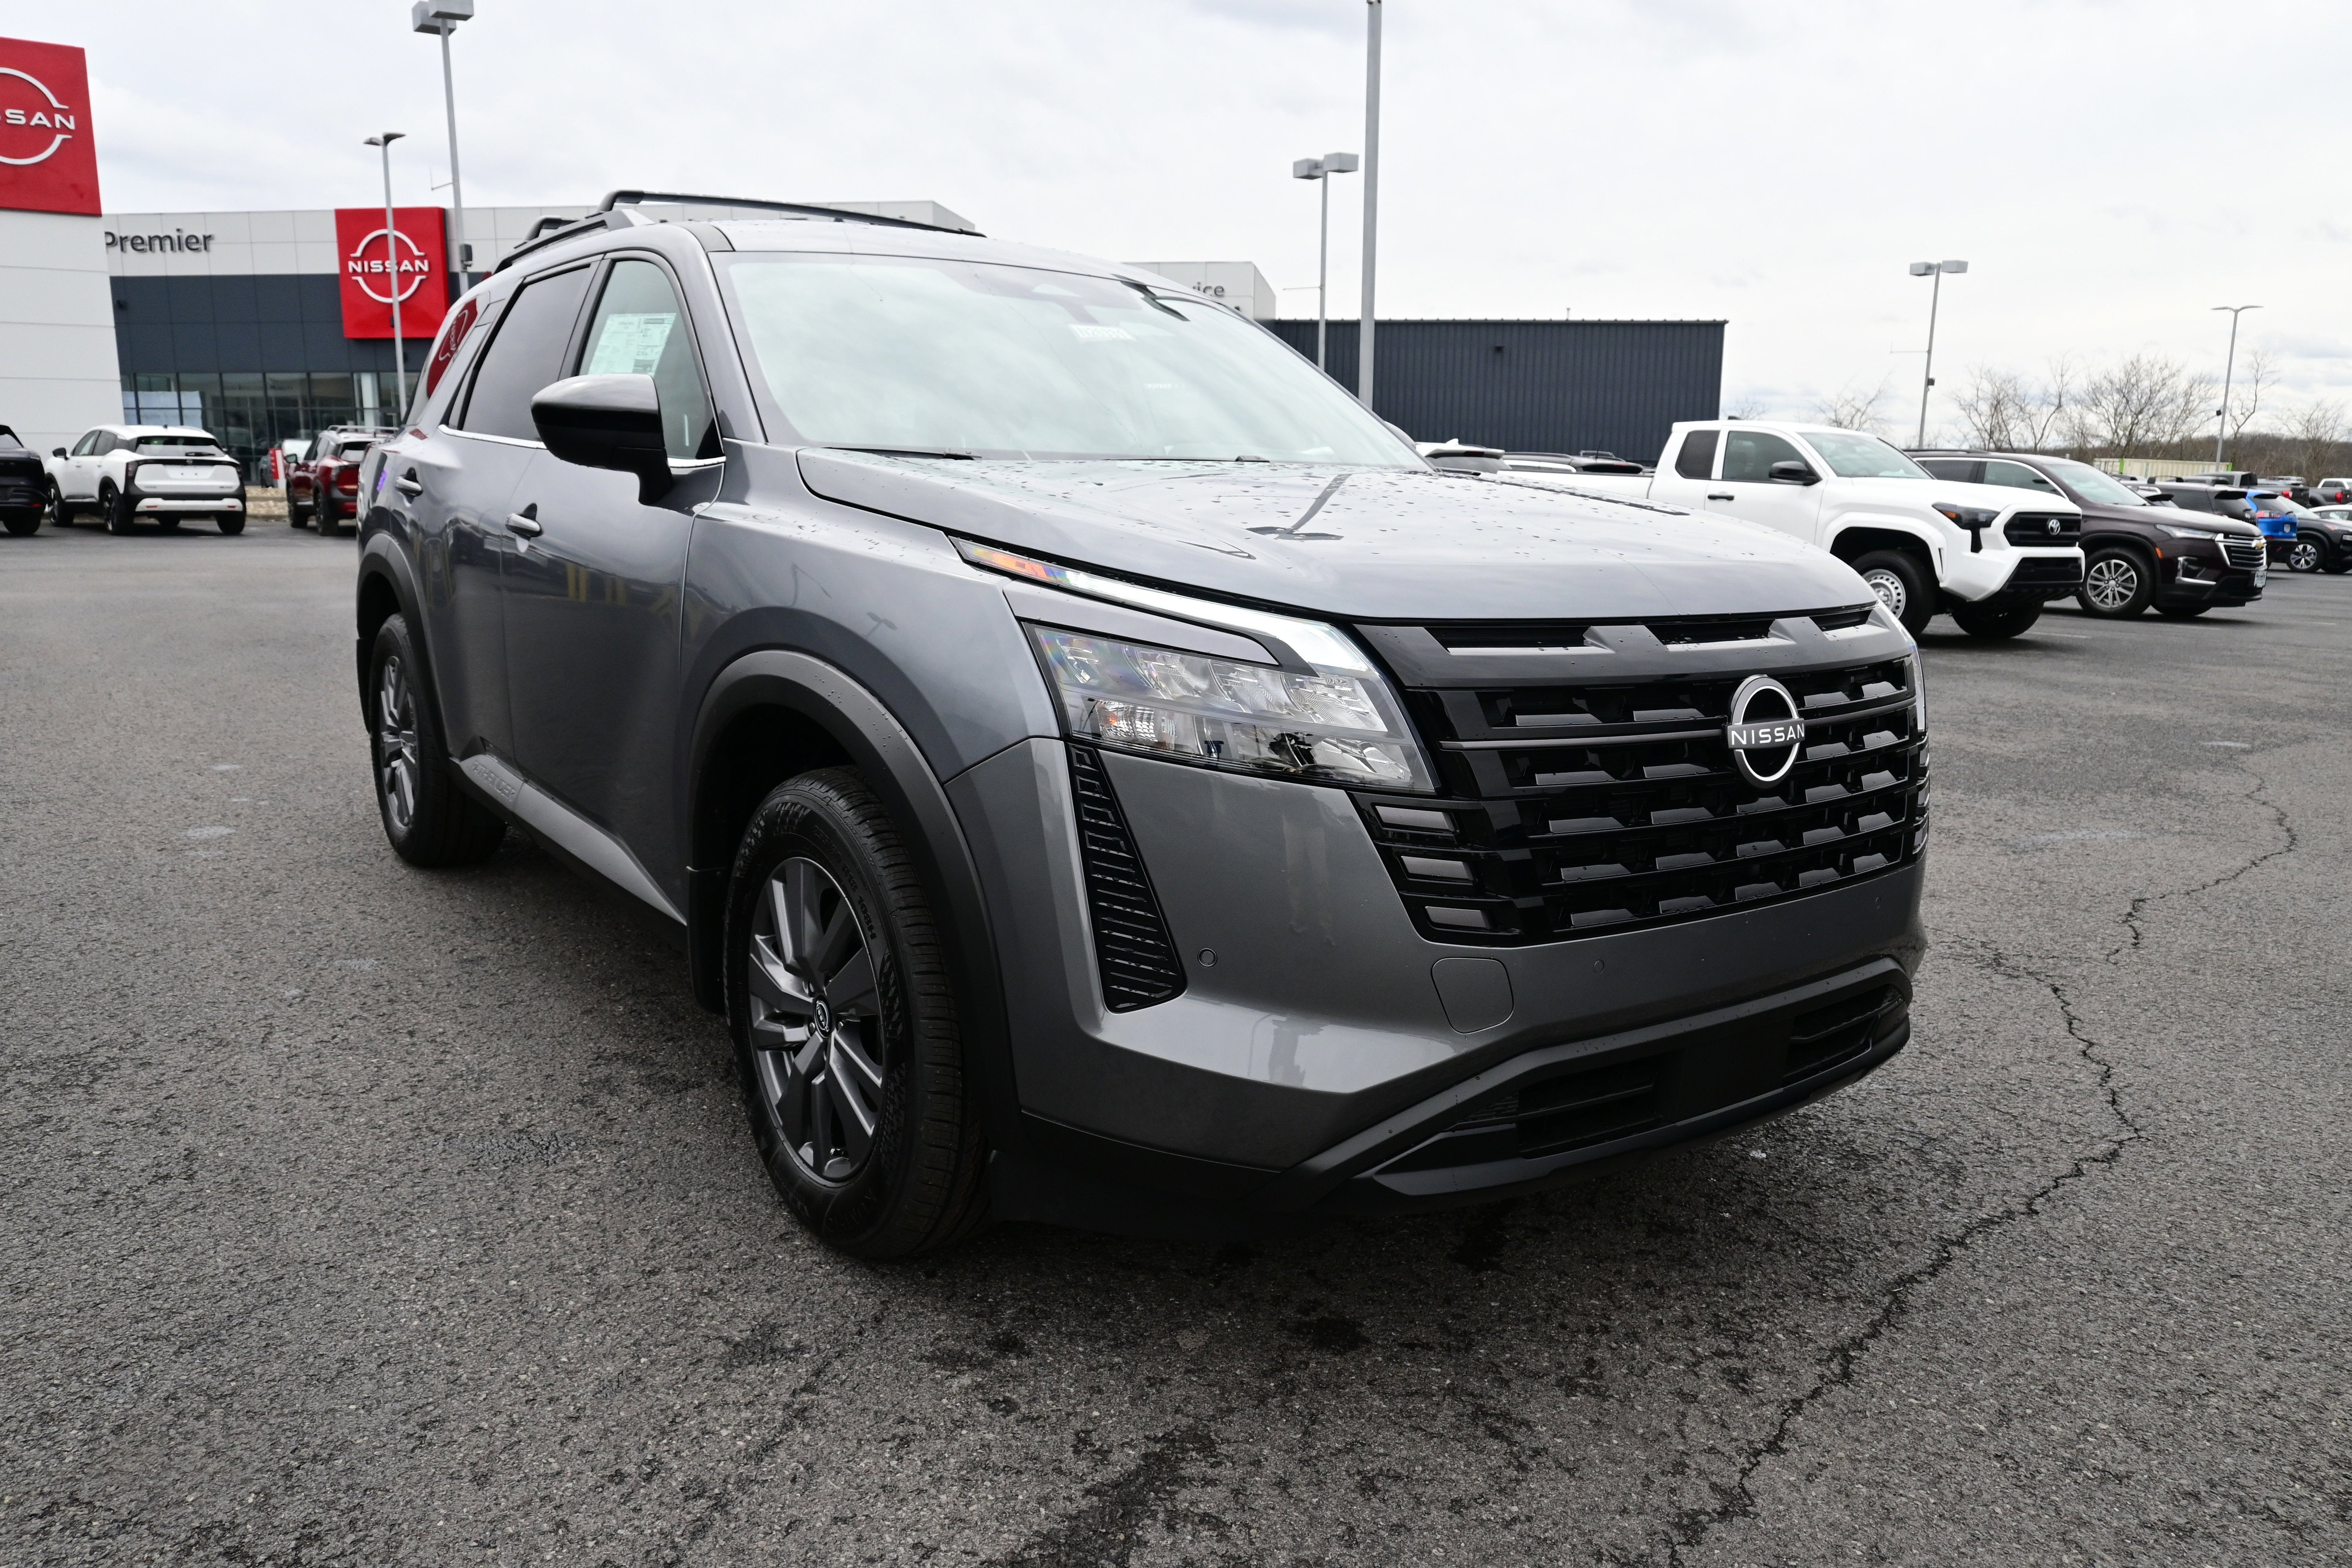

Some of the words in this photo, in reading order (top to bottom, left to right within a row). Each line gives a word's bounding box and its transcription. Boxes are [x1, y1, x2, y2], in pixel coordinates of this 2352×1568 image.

[0, 109, 76, 131] SAN
[104, 228, 213, 253] Premier
[348, 259, 429, 273] NISSAN
[1731, 723, 1805, 746] NISSAN
[858, 894, 877, 940] 108H
